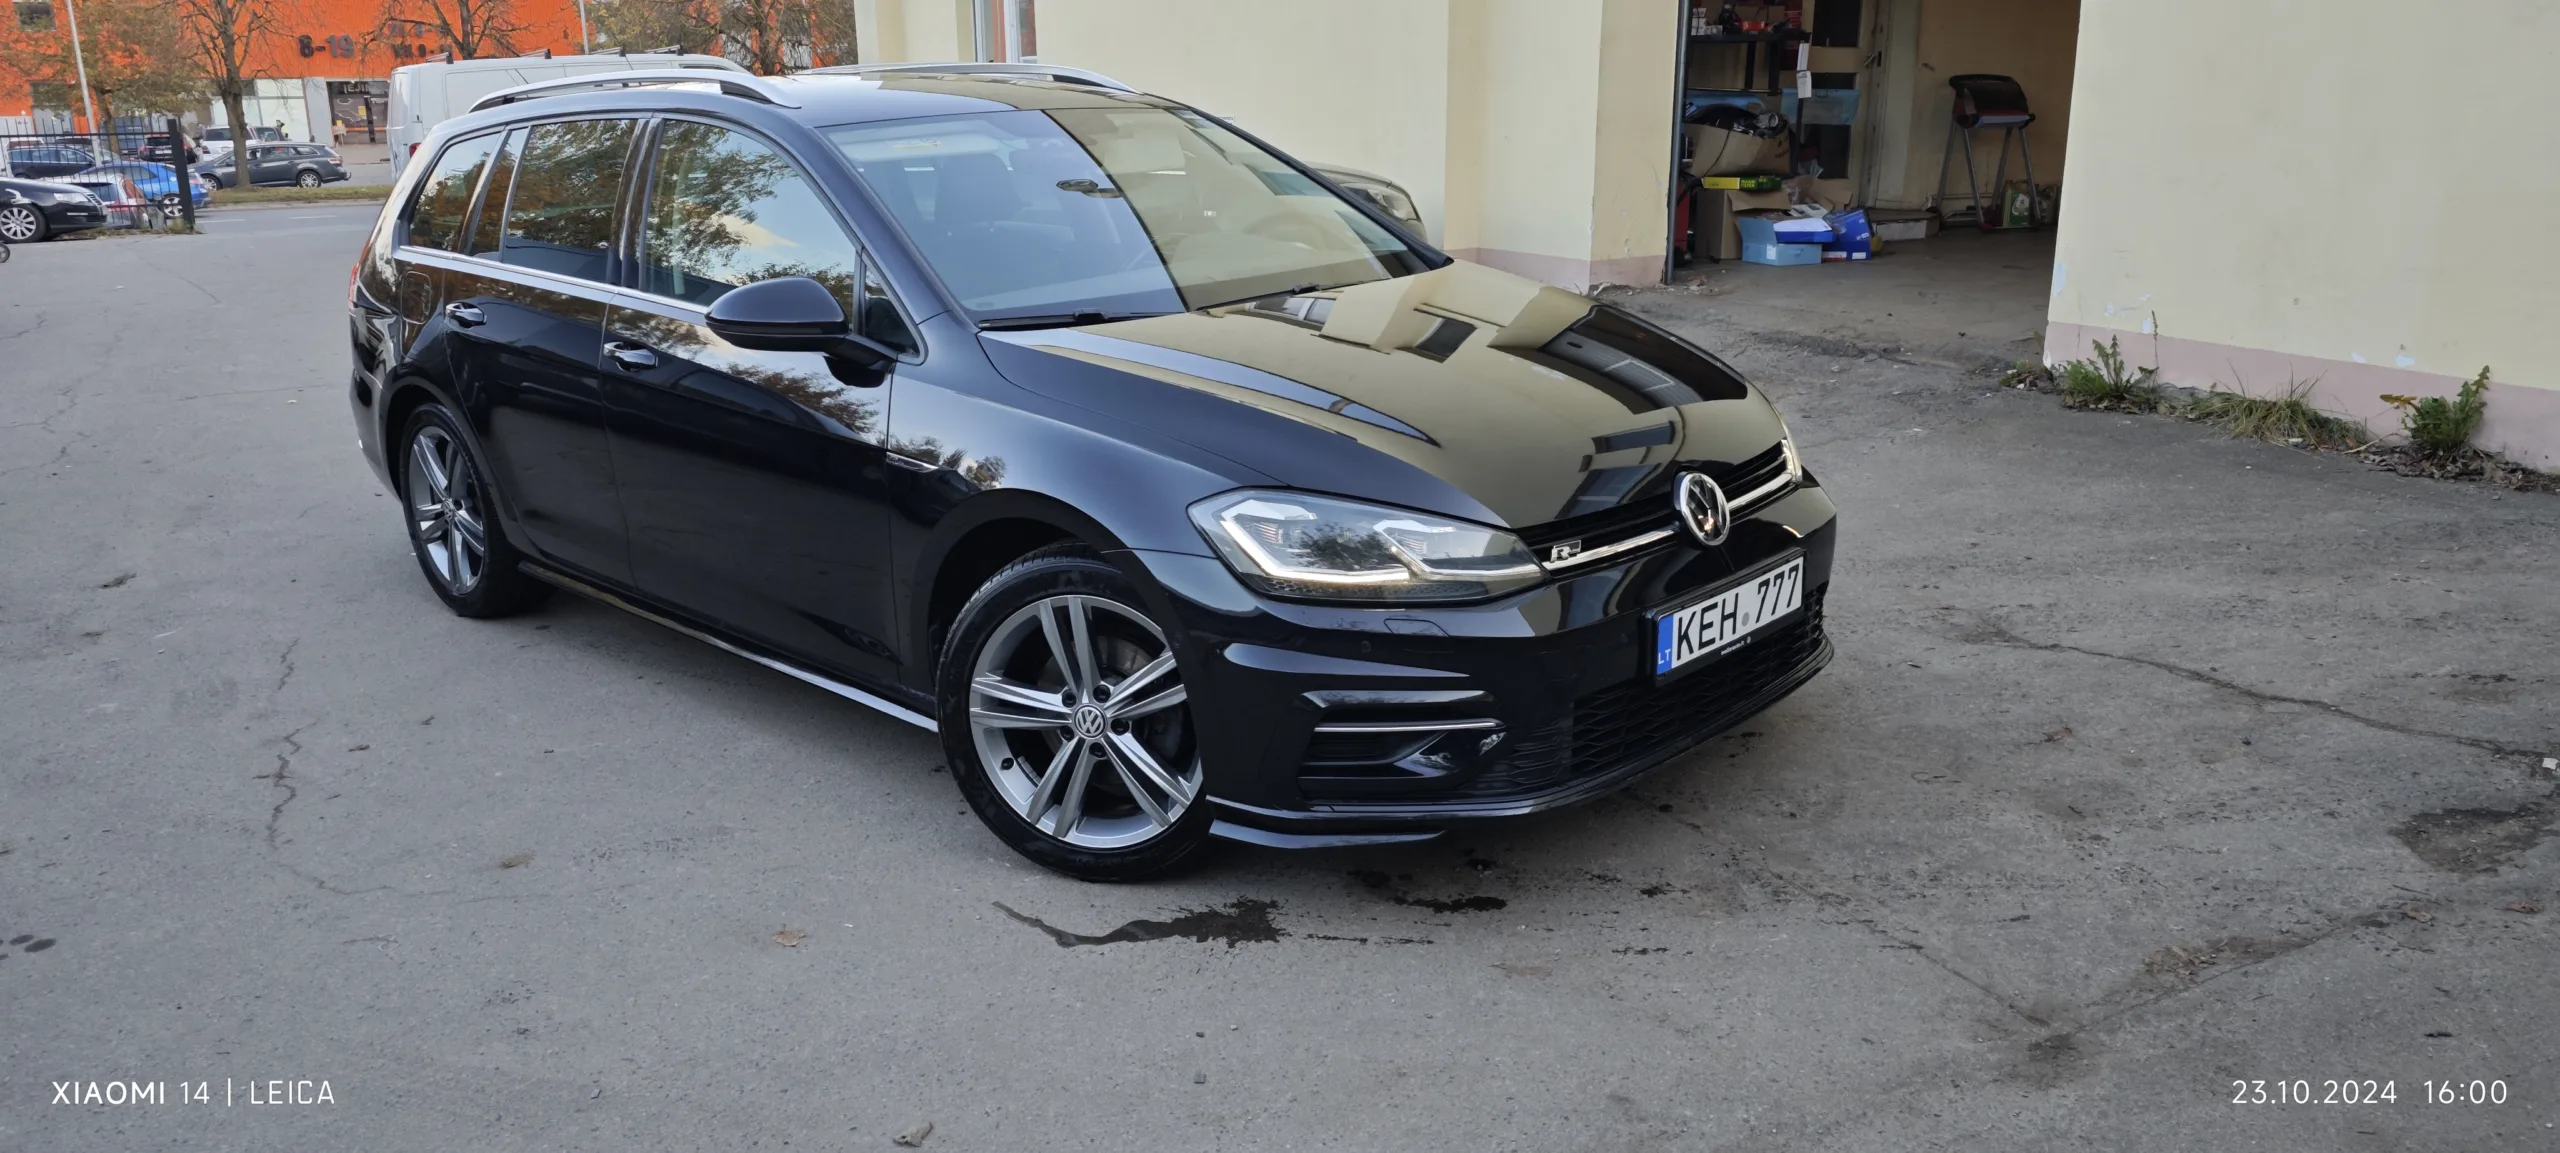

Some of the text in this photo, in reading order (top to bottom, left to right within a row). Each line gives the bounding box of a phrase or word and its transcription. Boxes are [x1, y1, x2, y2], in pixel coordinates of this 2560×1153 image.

[1677, 563, 1800, 661] KEH 777
[1658, 649, 1671, 664] LT
